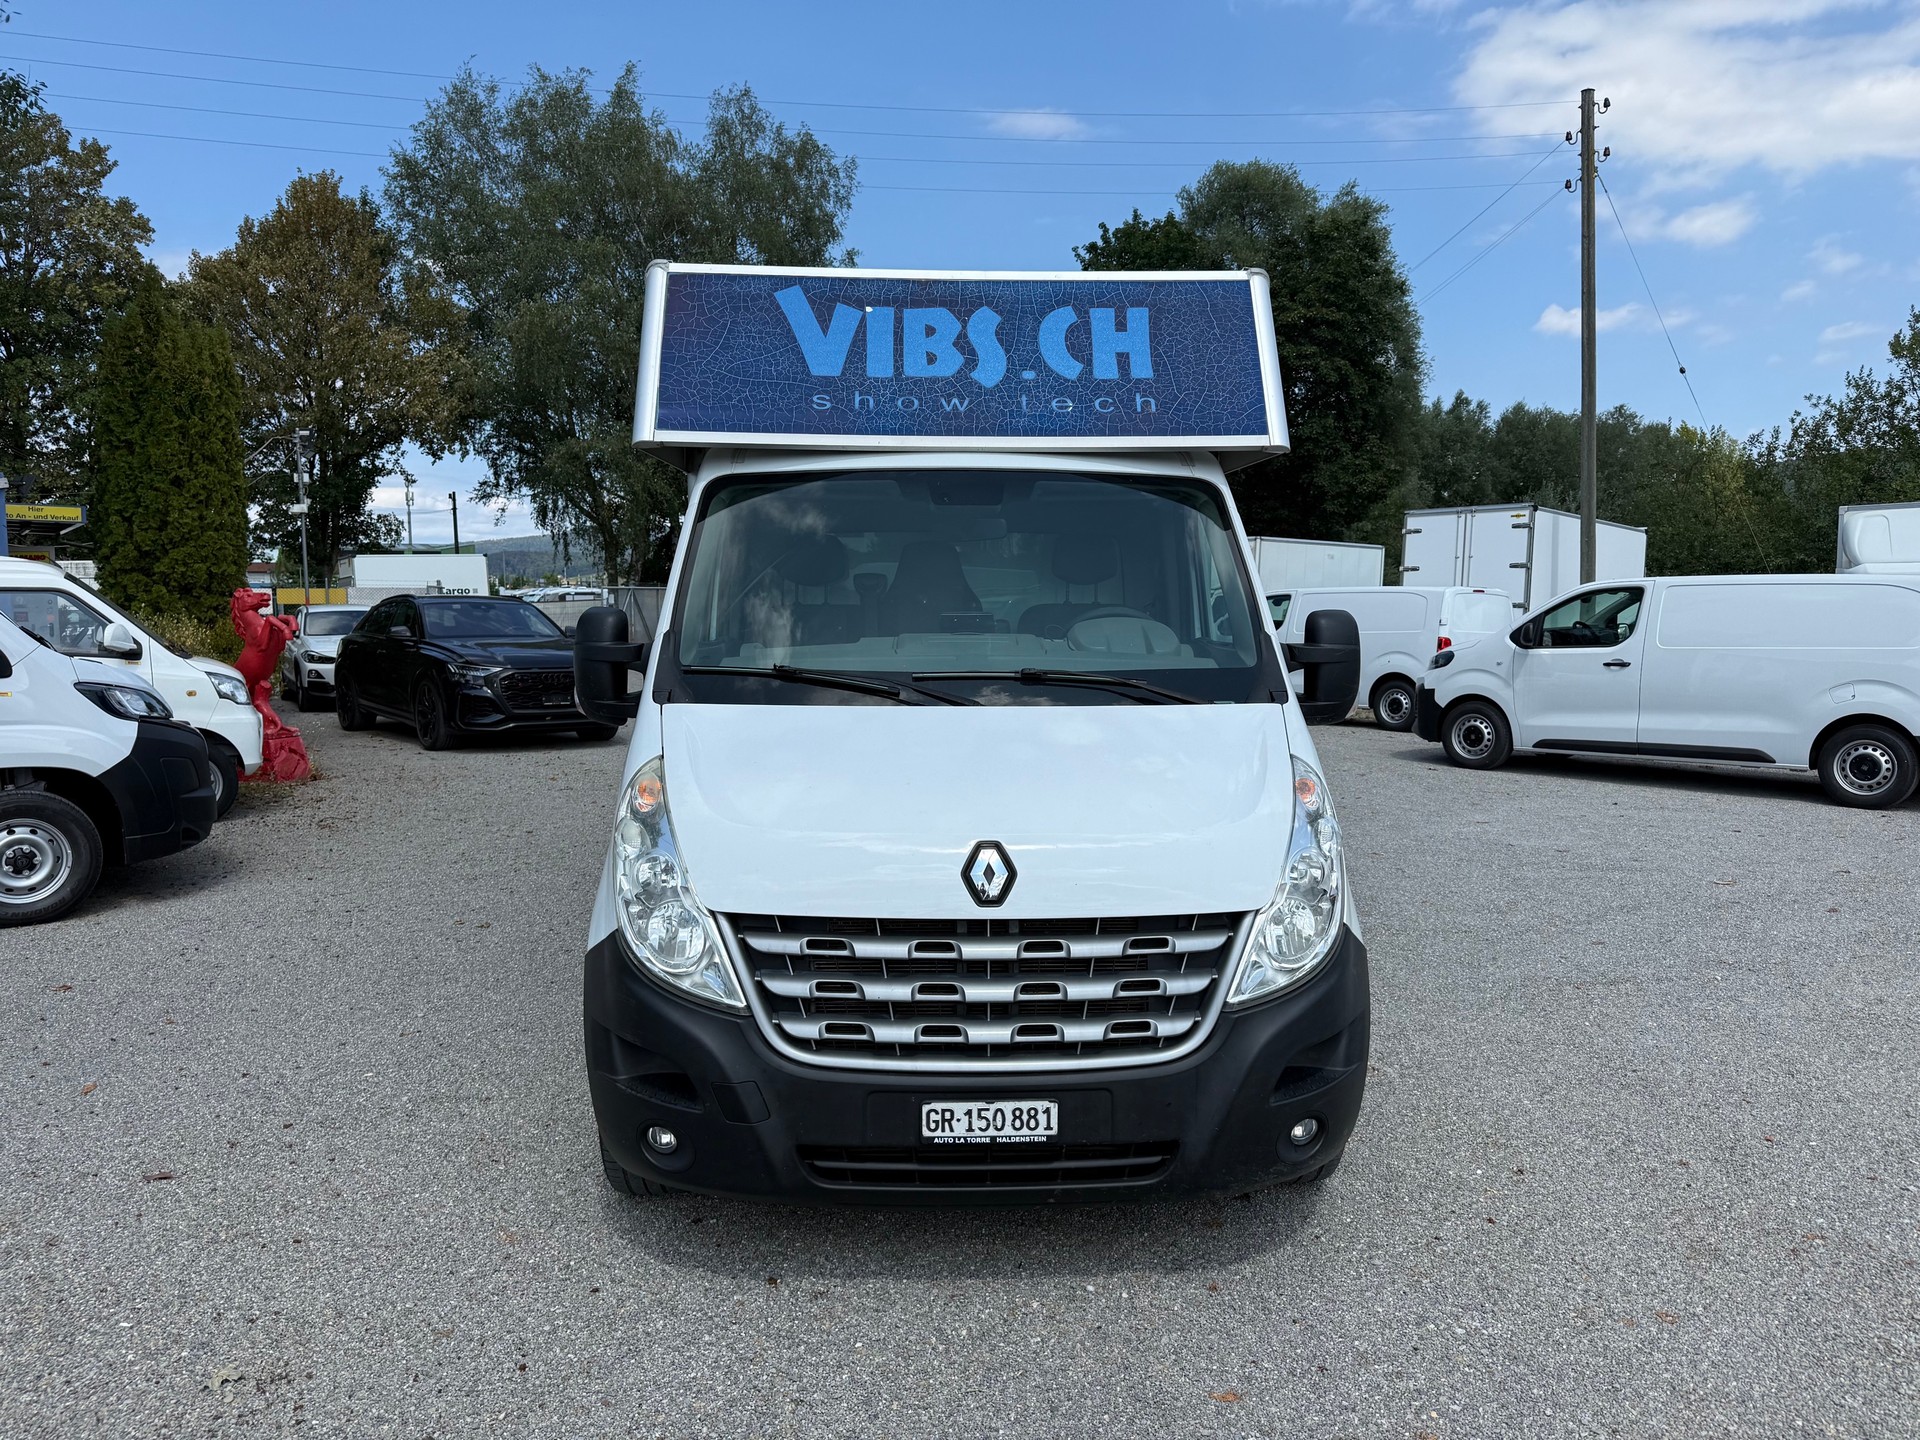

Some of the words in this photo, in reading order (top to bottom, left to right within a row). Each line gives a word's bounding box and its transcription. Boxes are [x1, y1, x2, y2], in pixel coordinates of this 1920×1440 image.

[774, 284, 1155, 389] VIBS.CH
[812, 391, 970, 412] show
[1020, 391, 1157, 413] tech
